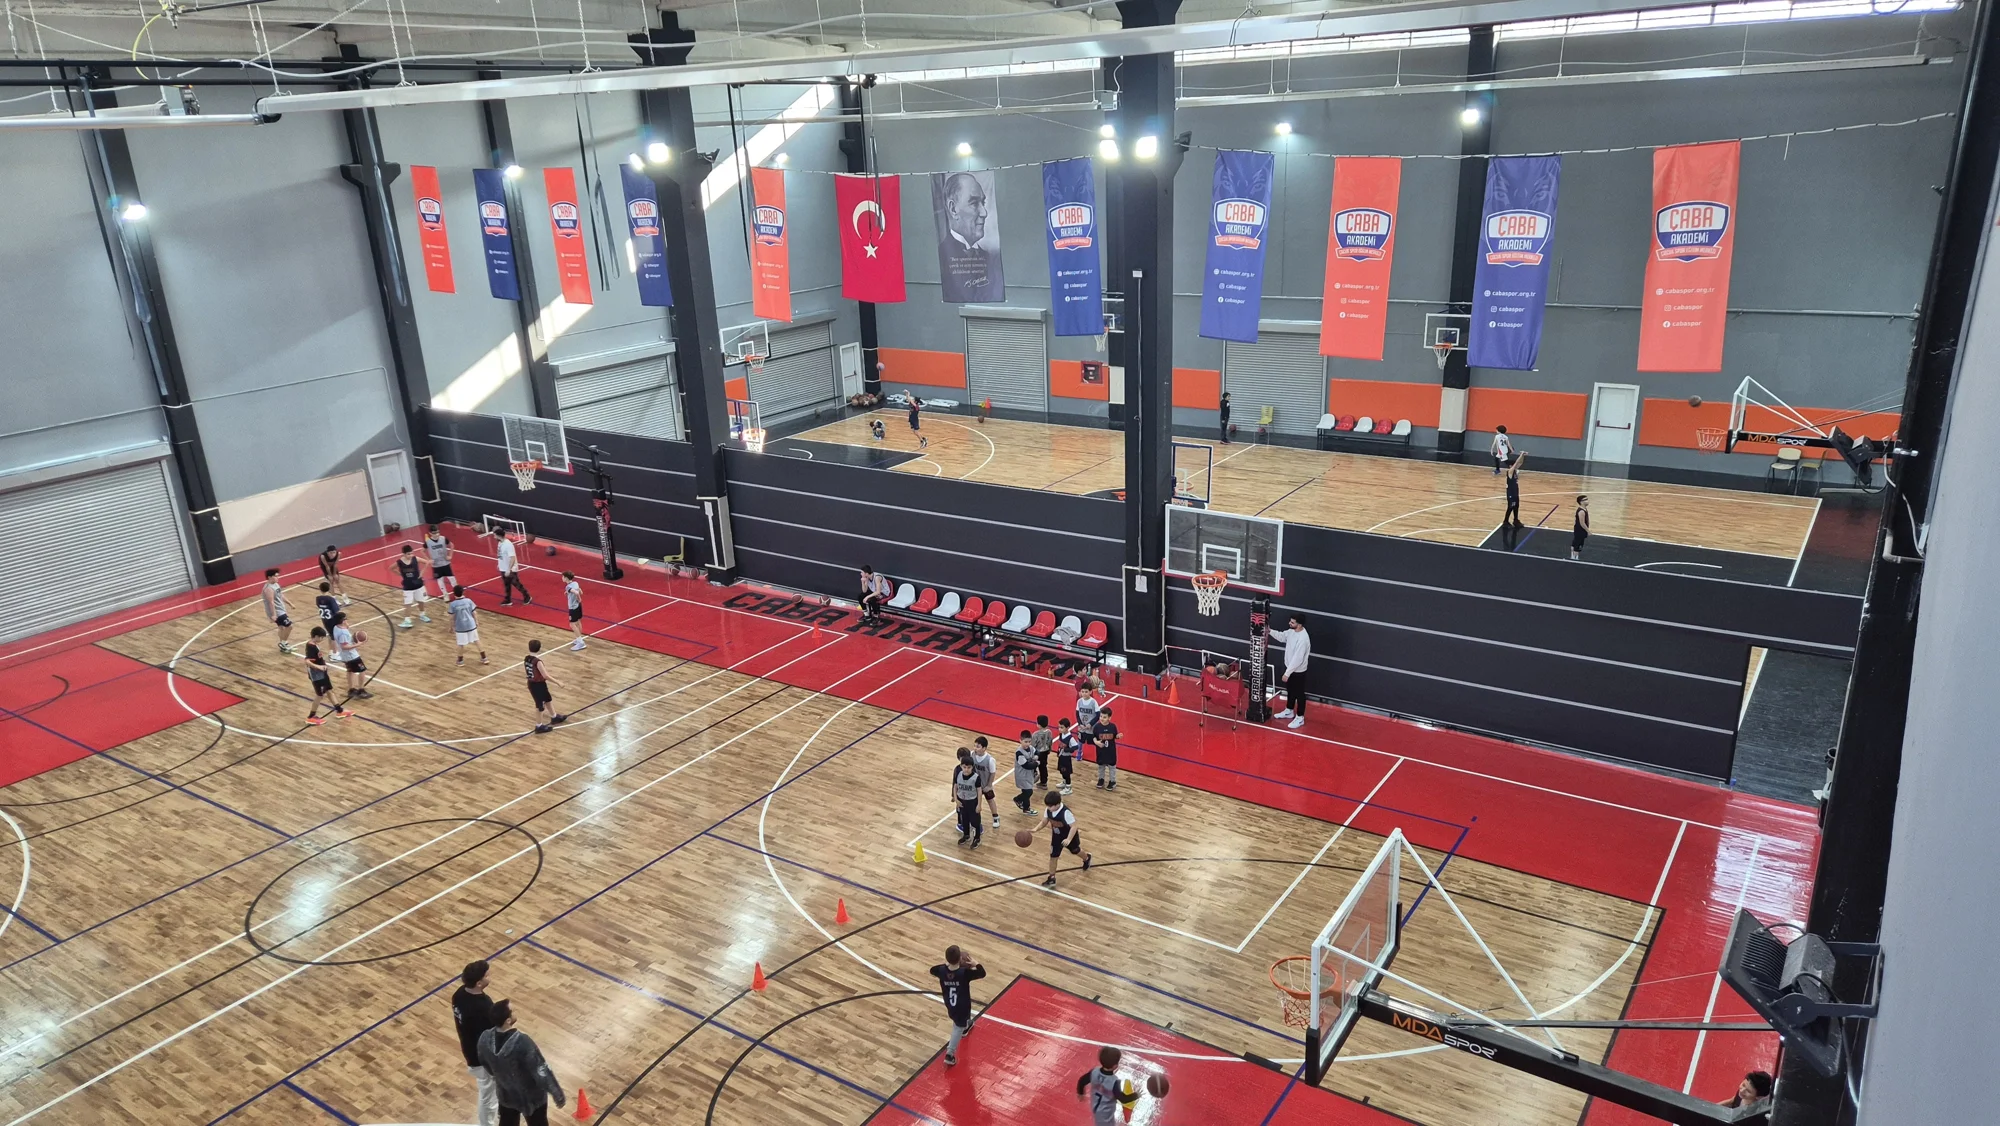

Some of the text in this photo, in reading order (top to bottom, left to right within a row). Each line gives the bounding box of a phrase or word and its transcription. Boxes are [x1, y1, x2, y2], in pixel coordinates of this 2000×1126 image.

[1491, 290, 1537, 298] cabaspor.org.tr
[1664, 287, 1715, 295] cabaspor.org.tr
[1498, 305, 1525, 313] cabaspor
[1673, 303, 1704, 311] cabaspor
[1496, 320, 1524, 329] cabaspor
[1671, 320, 1702, 328] cabaspor
[319, 608, 332, 620] 23
[949, 987, 958, 1007] 5
